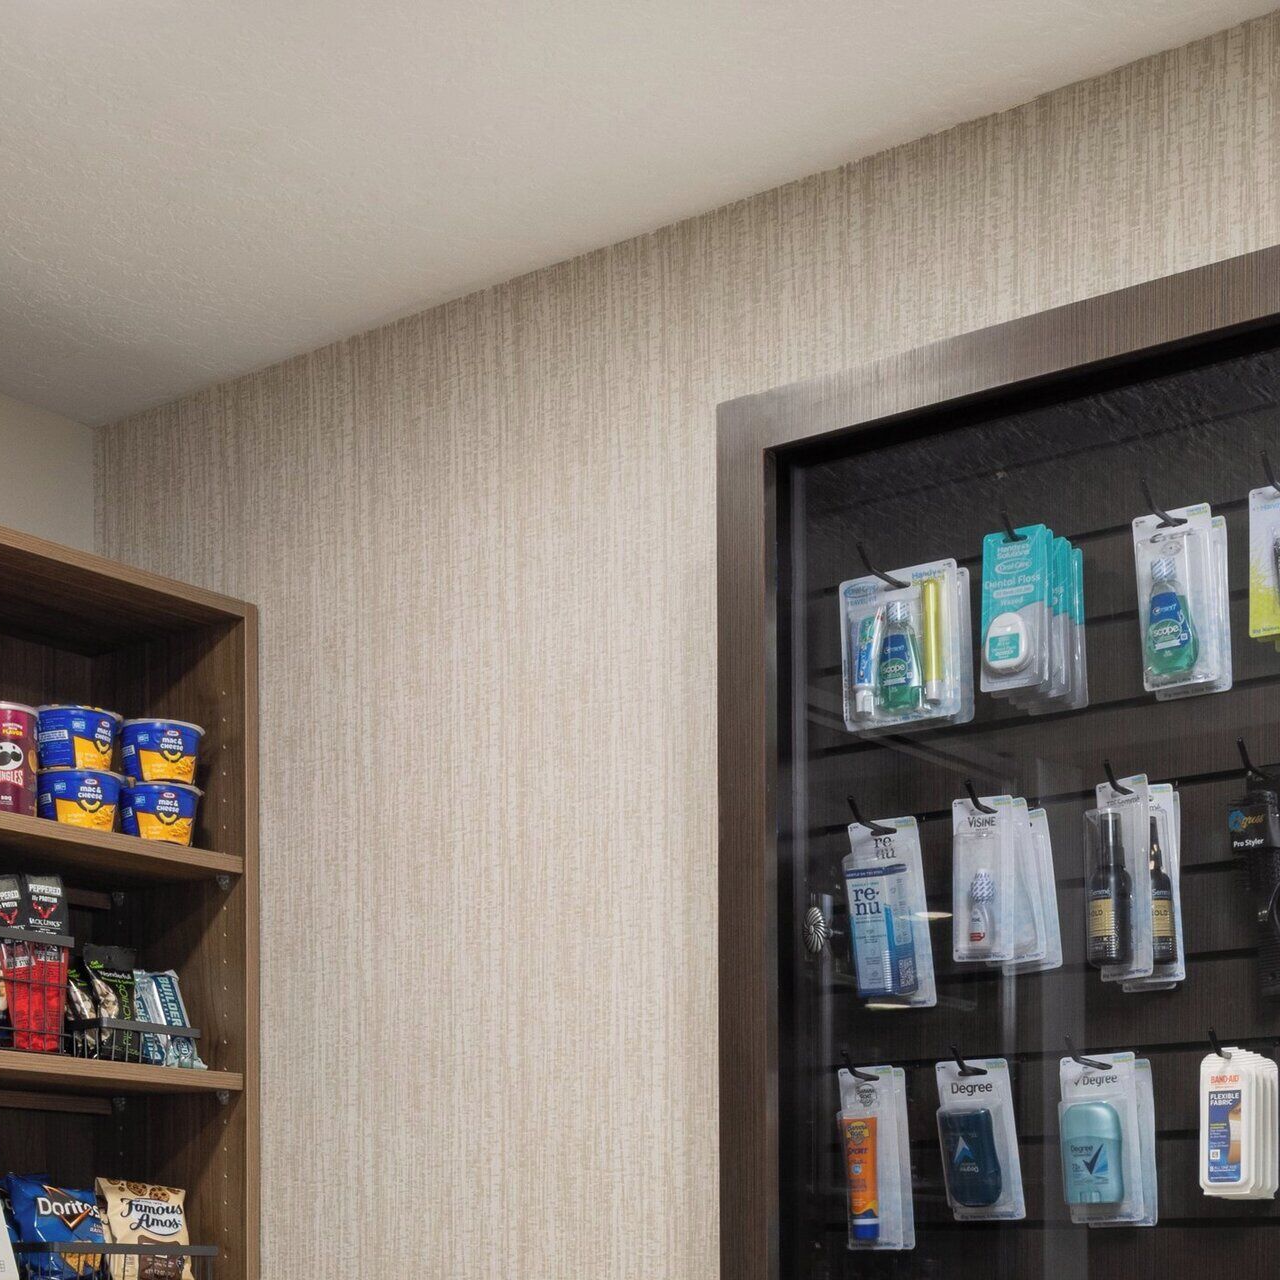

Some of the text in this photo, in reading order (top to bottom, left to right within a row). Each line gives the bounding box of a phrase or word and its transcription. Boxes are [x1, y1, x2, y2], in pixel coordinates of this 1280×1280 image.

[985, 574, 1040, 589] Dental Floss
[1152, 625, 1179, 637] scope
[968, 816, 996, 828] VISINE
[1245, 838, 1264, 847] Styler
[29, 884, 62, 896] PEPPERED
[1082, 1075, 1117, 1087] Degree
[1210, 1075, 1239, 1084] BAND-AID
[950, 1080, 993, 1097] Degree
[37, 1197, 100, 1218] Doritos
[121, 1198, 183, 1217] Famous
[130, 1214, 178, 1230] Amos
